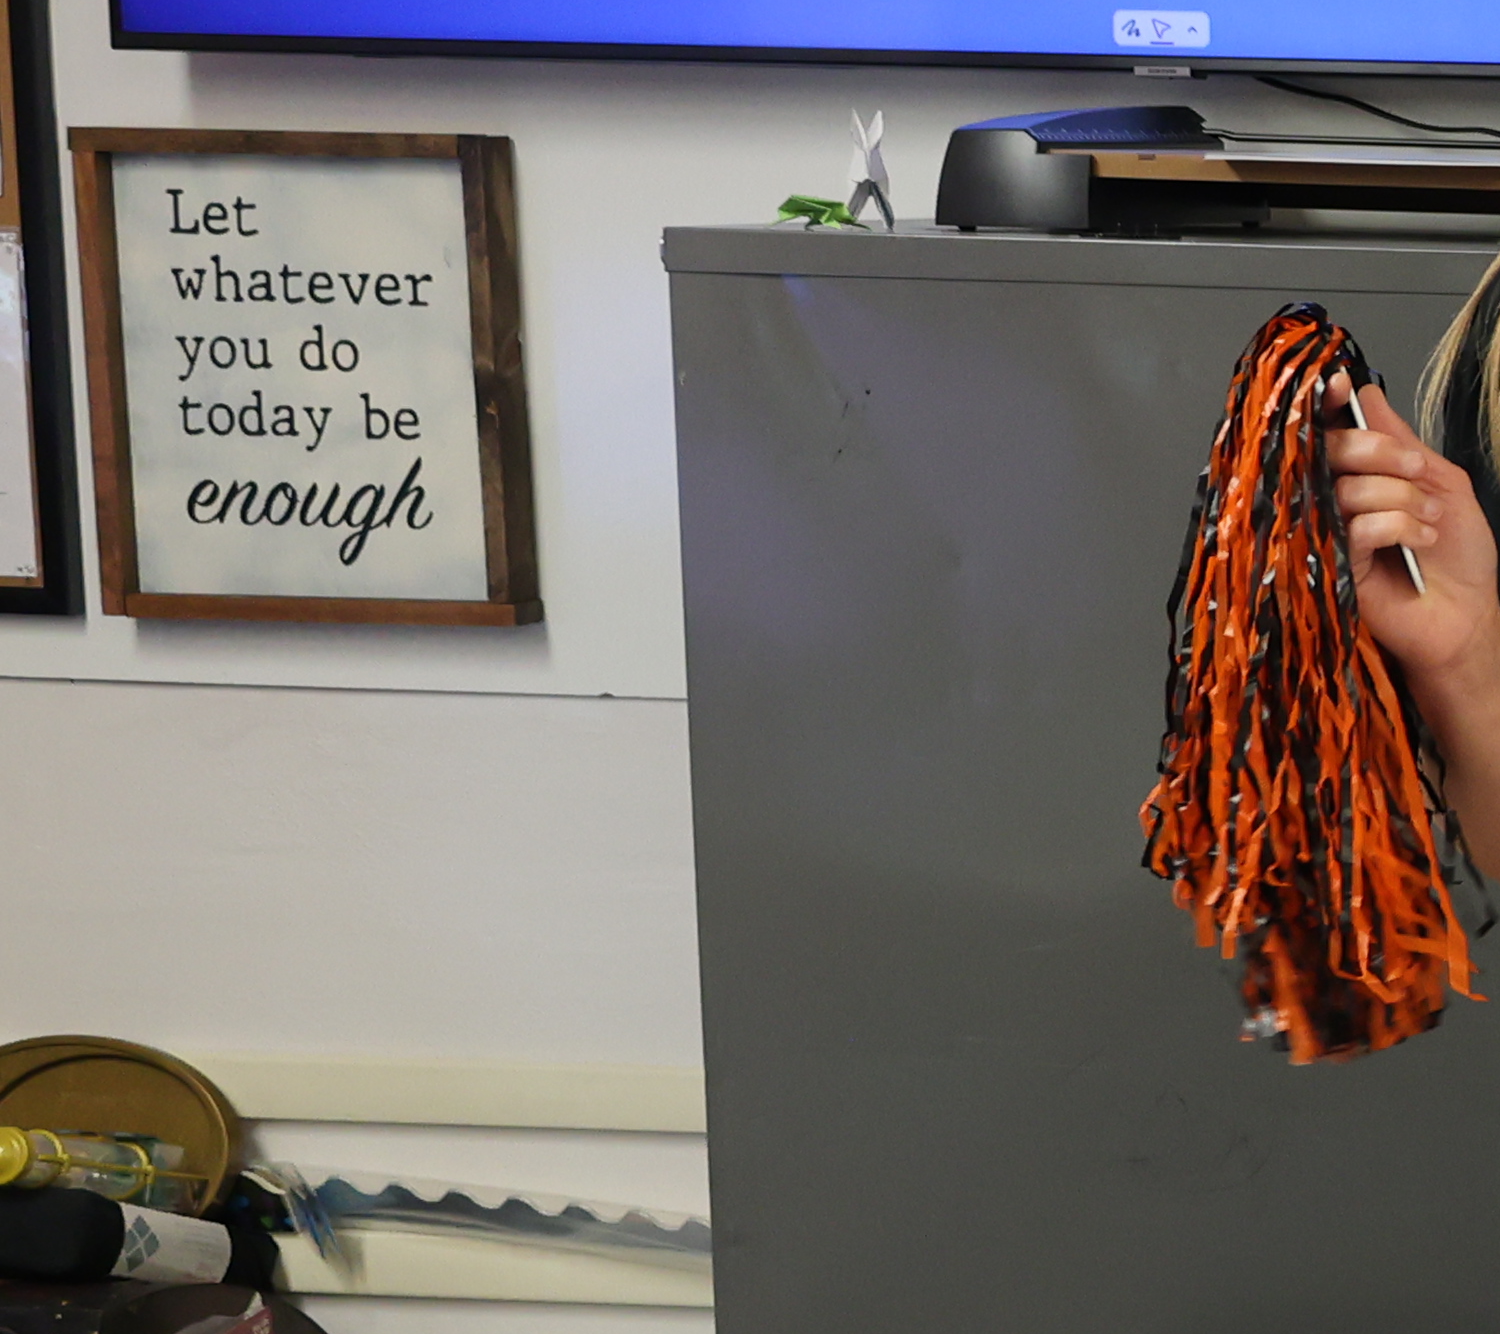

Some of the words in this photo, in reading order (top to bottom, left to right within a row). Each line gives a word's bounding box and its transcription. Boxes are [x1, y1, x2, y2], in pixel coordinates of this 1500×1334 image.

[165, 187, 260, 238] Let
[170, 254, 434, 307] whatever
[174, 330, 273, 382] you
[298, 324, 361, 373] do
[178, 390, 334, 451] today
[359, 392, 422, 442] be
[185, 455, 434, 567] enough
